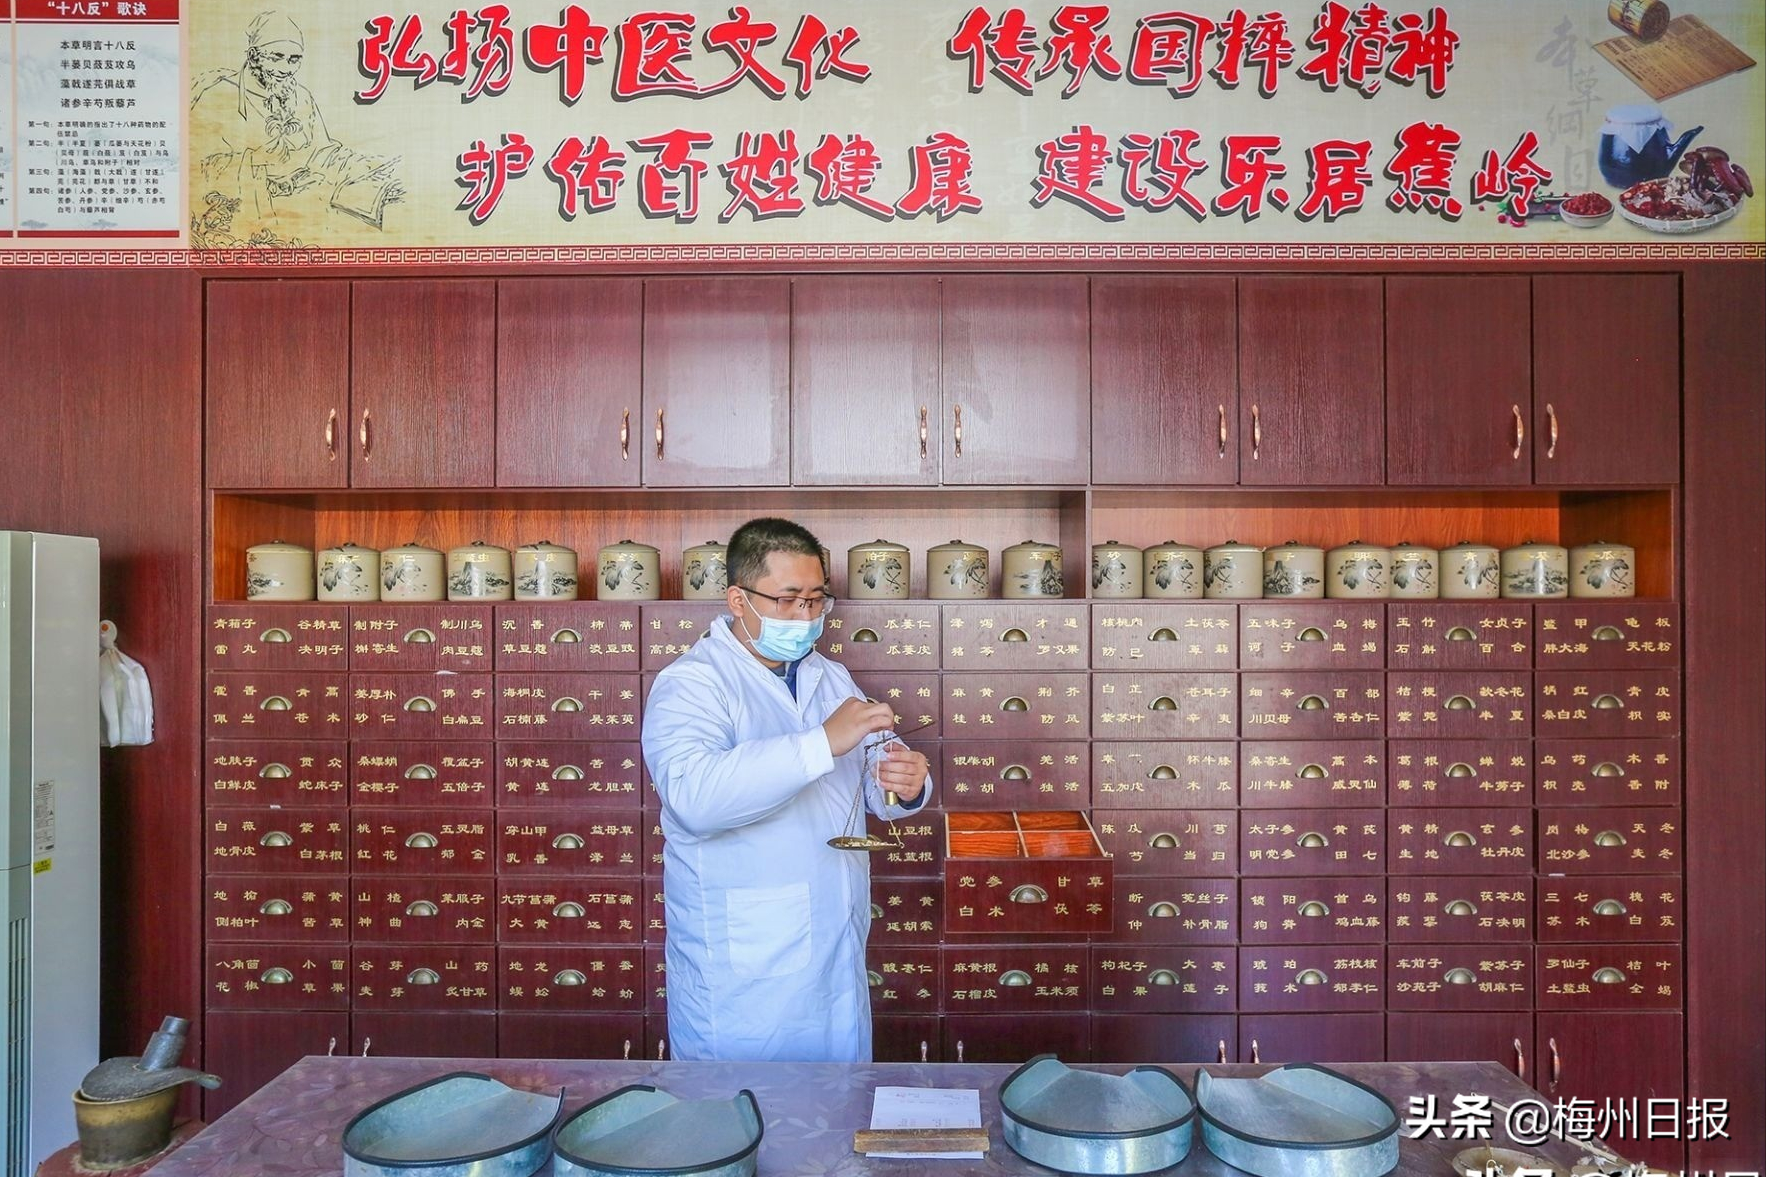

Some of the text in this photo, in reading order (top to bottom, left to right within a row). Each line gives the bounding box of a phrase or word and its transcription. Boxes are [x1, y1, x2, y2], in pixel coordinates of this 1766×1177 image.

[60, 40, 136, 51] 本草明言十八反
[355, 5, 873, 101] 弘扬中医文化
[947, 1, 1461, 98] 传承国粹精神
[455, 127, 983, 225] 护佑百姓健康
[1031, 121, 1553, 223] 建设乐居蕉岭
